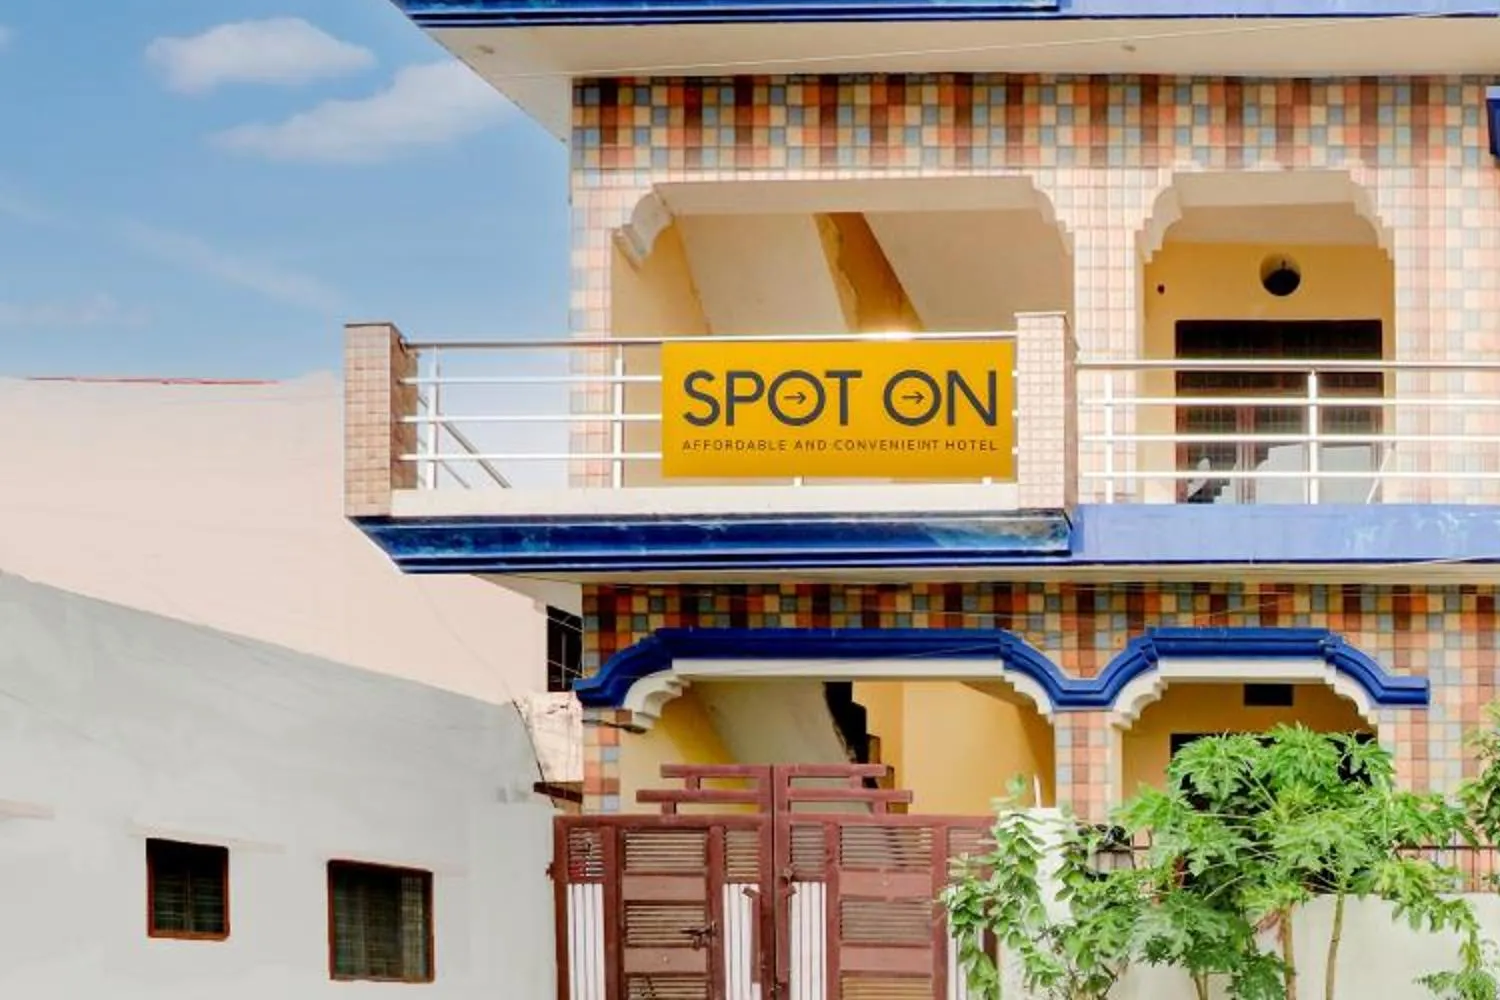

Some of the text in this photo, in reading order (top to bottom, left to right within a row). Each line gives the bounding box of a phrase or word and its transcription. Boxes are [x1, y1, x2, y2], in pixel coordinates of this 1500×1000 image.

[683, 369, 997, 427] SPOT ON
[682, 439, 787, 451] AFFORDABLE
[794, 439, 828, 451] AND
[945, 439, 998, 451] HOTEL
